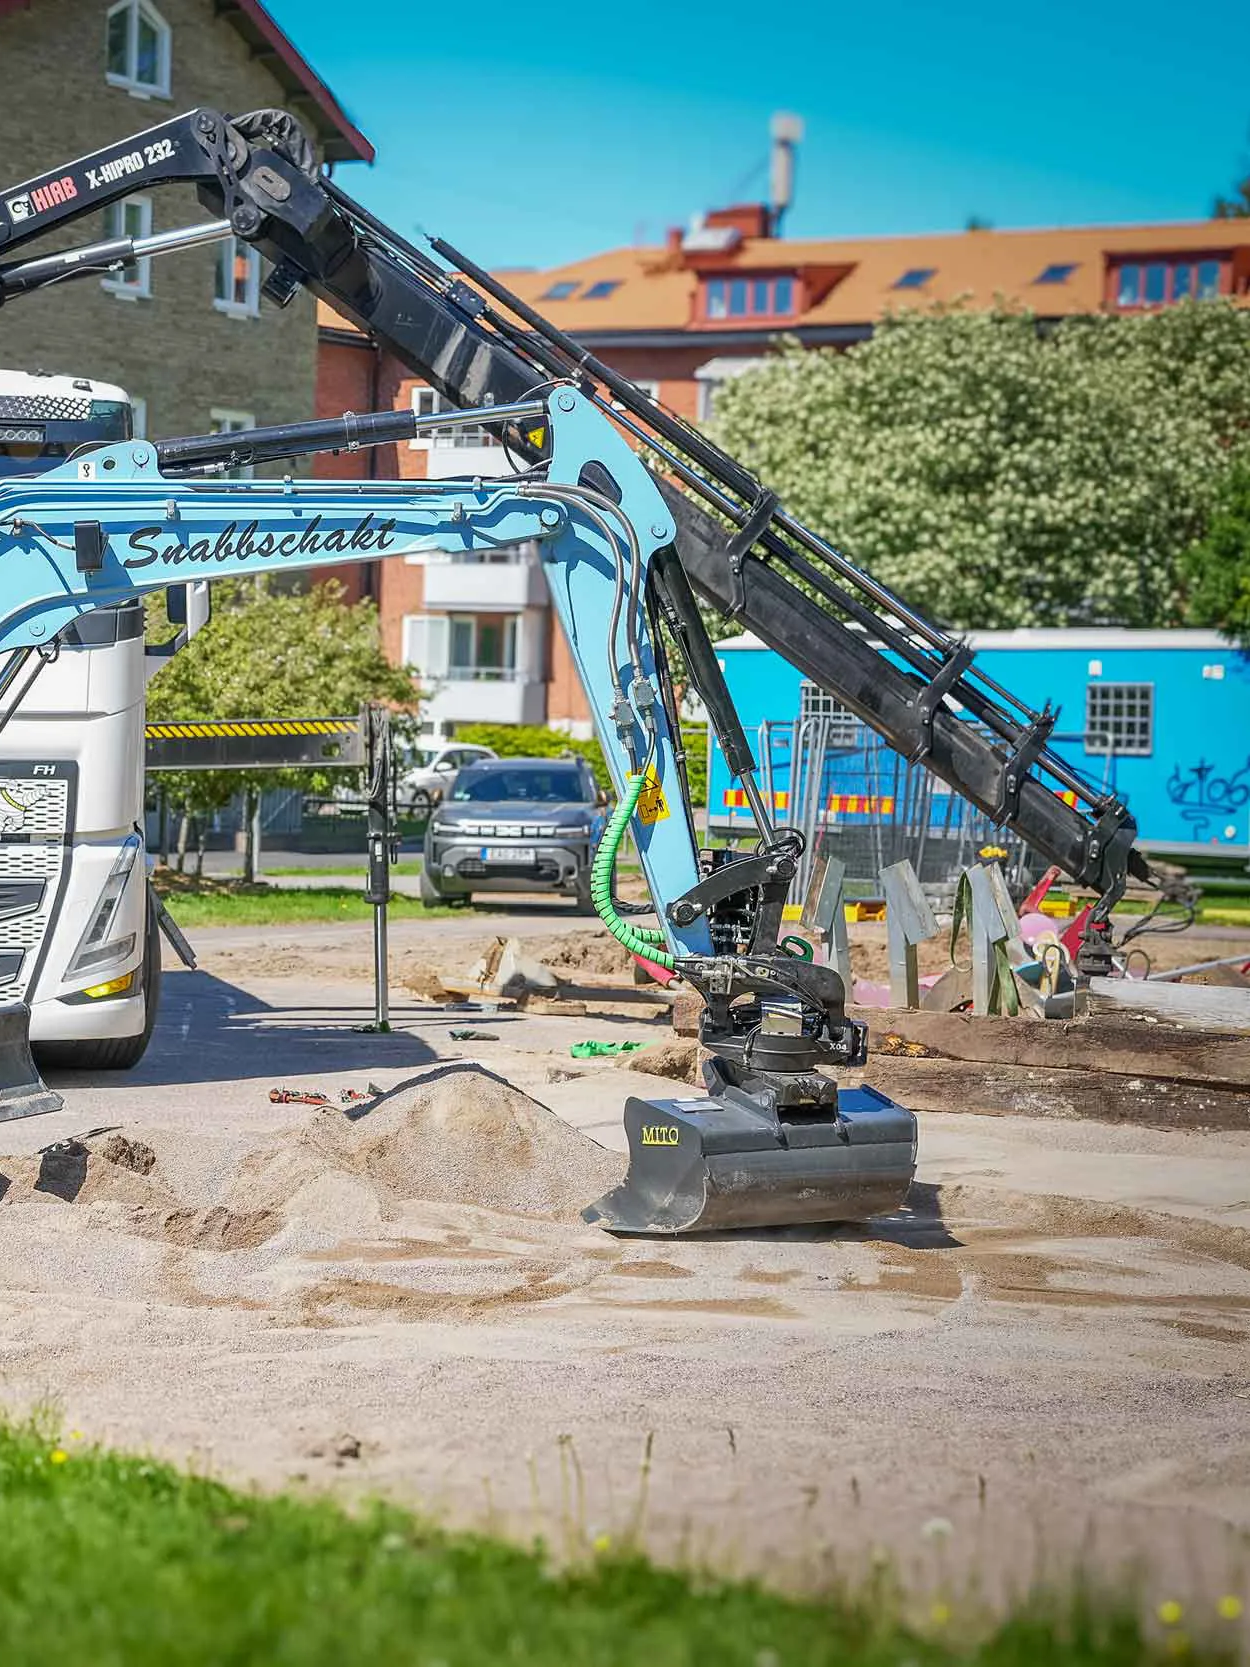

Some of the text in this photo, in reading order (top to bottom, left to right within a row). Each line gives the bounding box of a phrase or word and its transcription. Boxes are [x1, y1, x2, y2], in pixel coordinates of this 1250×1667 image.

[30, 138, 176, 212] HIAB X-HIPRO 232
[123, 512, 397, 569] Snabbschakt
[33, 765, 56, 775] FH
